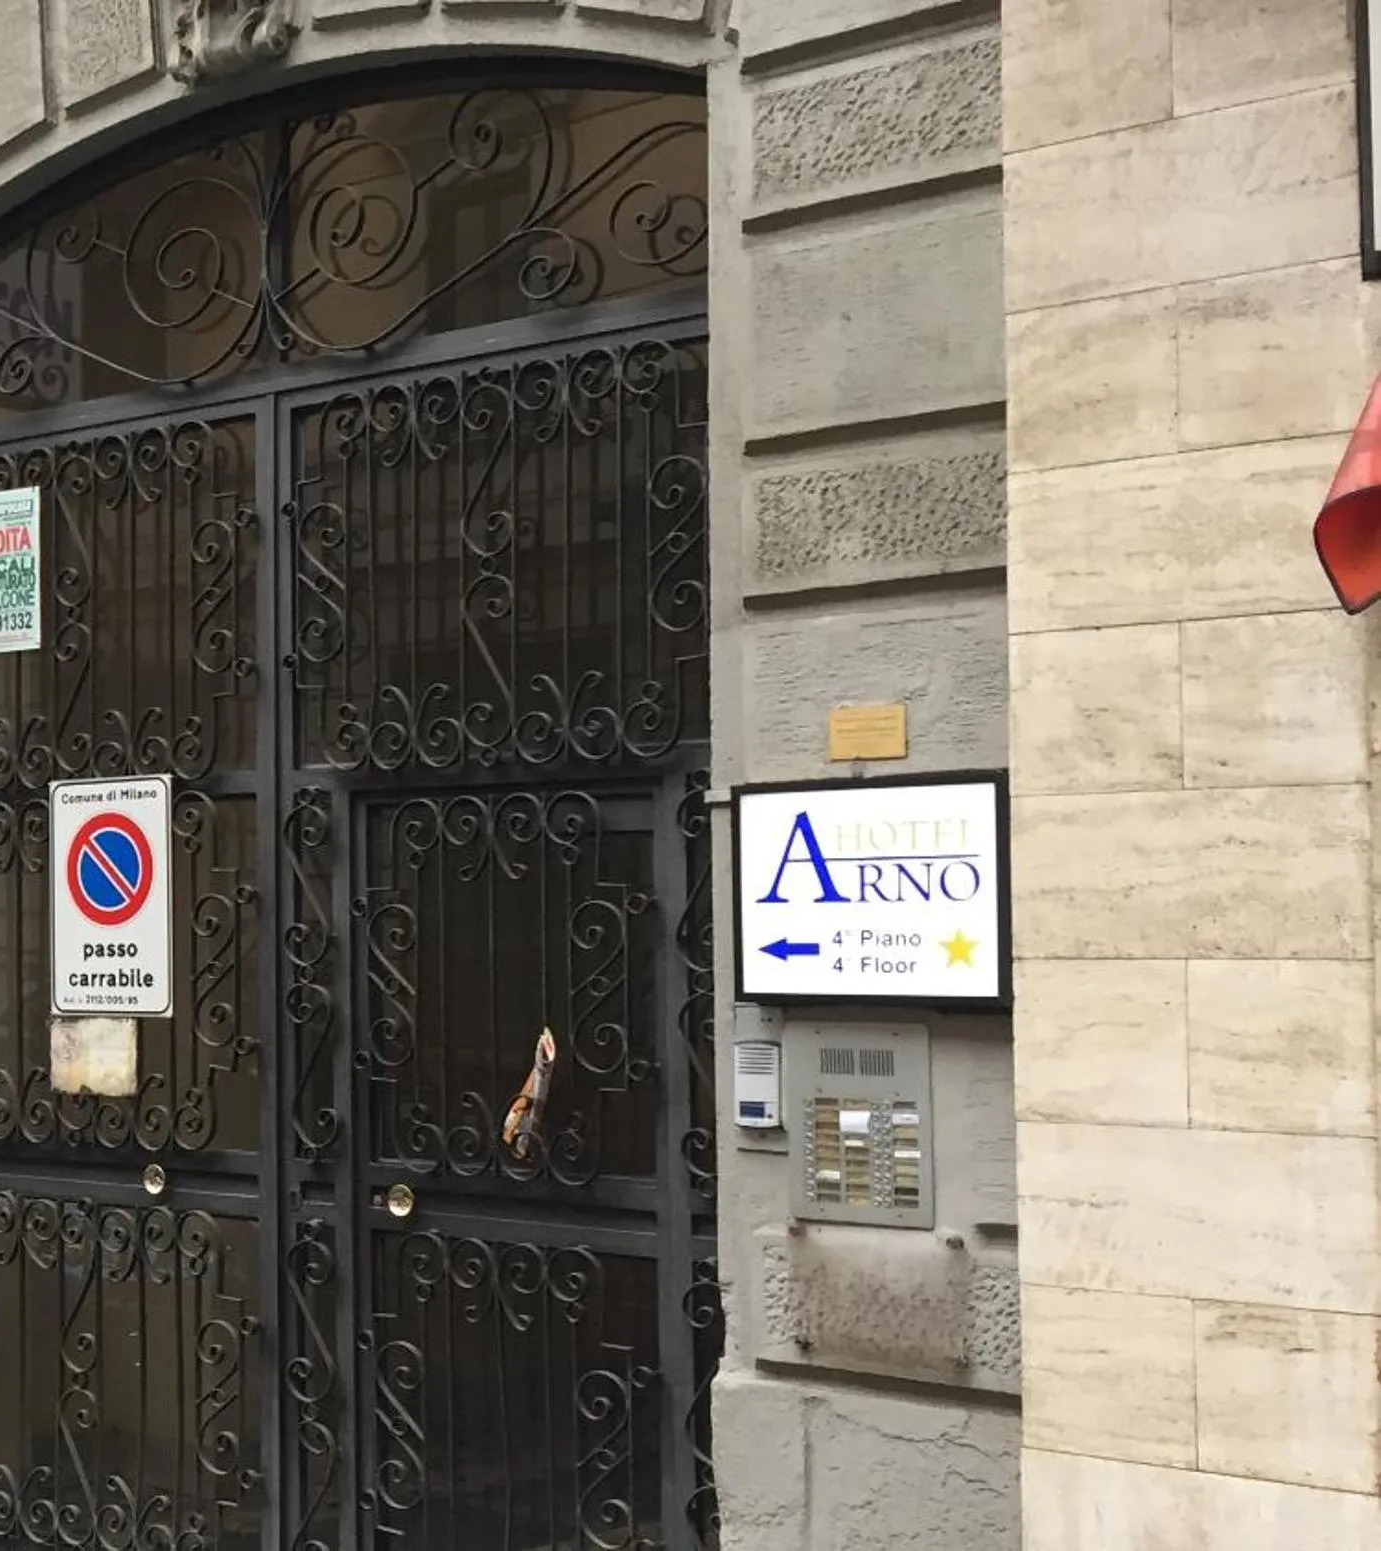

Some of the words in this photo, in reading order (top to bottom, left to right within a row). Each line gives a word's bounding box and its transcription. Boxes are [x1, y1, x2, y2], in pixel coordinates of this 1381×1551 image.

[61, 793, 103, 804] Comune
[106, 790, 116, 800] di
[121, 788, 157, 800] Milano
[836, 818, 968, 852] HOTEL
[861, 930, 922, 947] Piano
[83, 943, 138, 961] passo
[861, 956, 917, 973] Floor
[69, 968, 154, 987] carrabile
